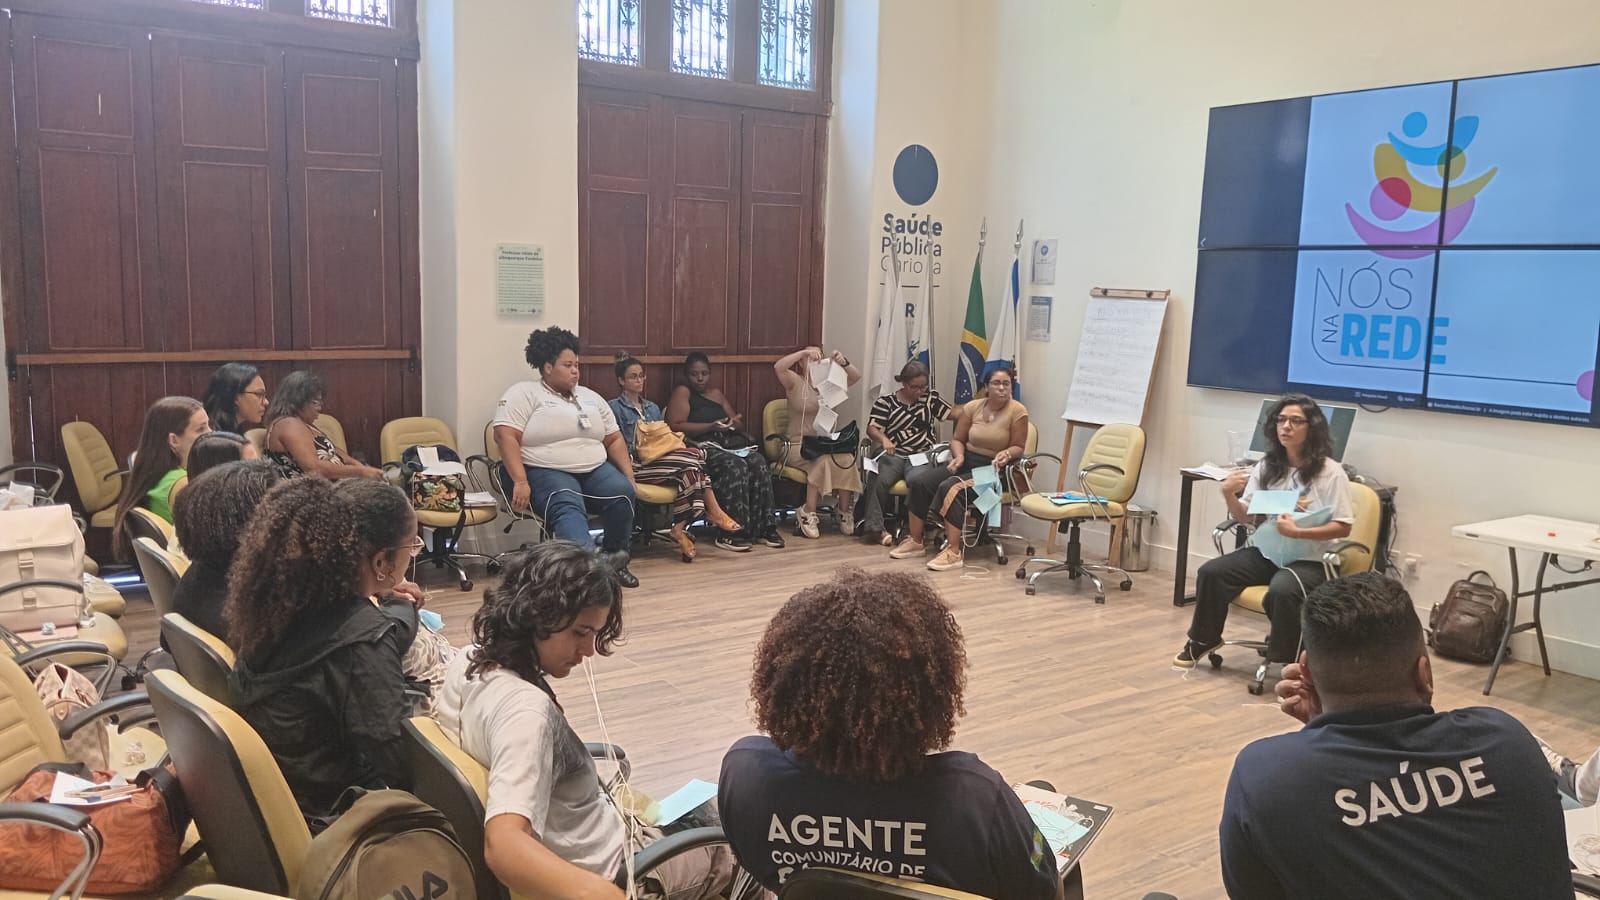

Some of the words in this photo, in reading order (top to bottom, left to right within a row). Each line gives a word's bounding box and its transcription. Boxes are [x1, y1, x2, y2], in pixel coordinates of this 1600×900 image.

[883, 213, 942, 236] Saúde
[1316, 260, 1413, 310] NÓS
[1321, 314, 1340, 343] NA
[1340, 313, 1450, 365] REDE
[1334, 756, 1496, 827] SAÚDE
[767, 813, 927, 855] AGENTE
[771, 850, 893, 874] COMUNITÁRIO
